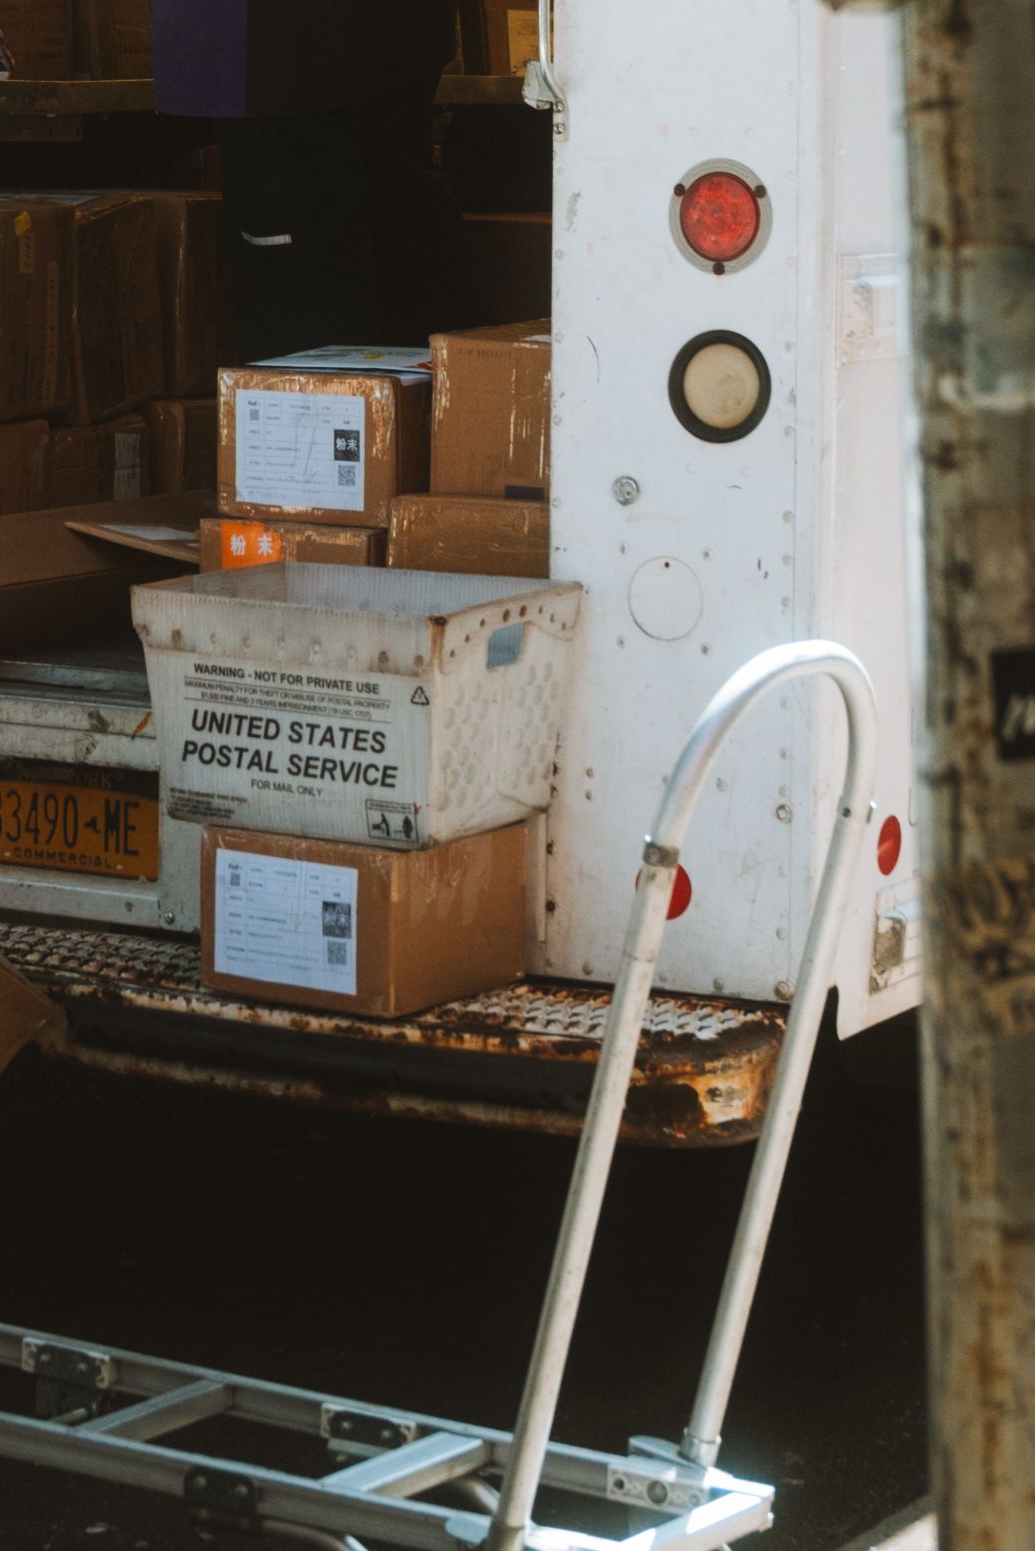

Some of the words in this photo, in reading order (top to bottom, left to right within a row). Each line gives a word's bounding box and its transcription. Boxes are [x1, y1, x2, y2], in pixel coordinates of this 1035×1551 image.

[193, 663, 245, 680] WARNING
[254, 670, 277, 682] NOT
[280, 673, 304, 686] FOR
[306, 676, 353, 691] PRIVATE
[356, 682, 380, 694] USE
[191, 709, 280, 741] UNITED
[288, 721, 387, 753] STATES
[182, 741, 279, 775] POSTAL
[287, 754, 399, 789] SERVICE
[250, 778, 271, 791] FOR
[272, 781, 296, 793] MAIL
[297, 784, 323, 797] ONLY
[12, 845, 113, 868] COMMERCIAL
